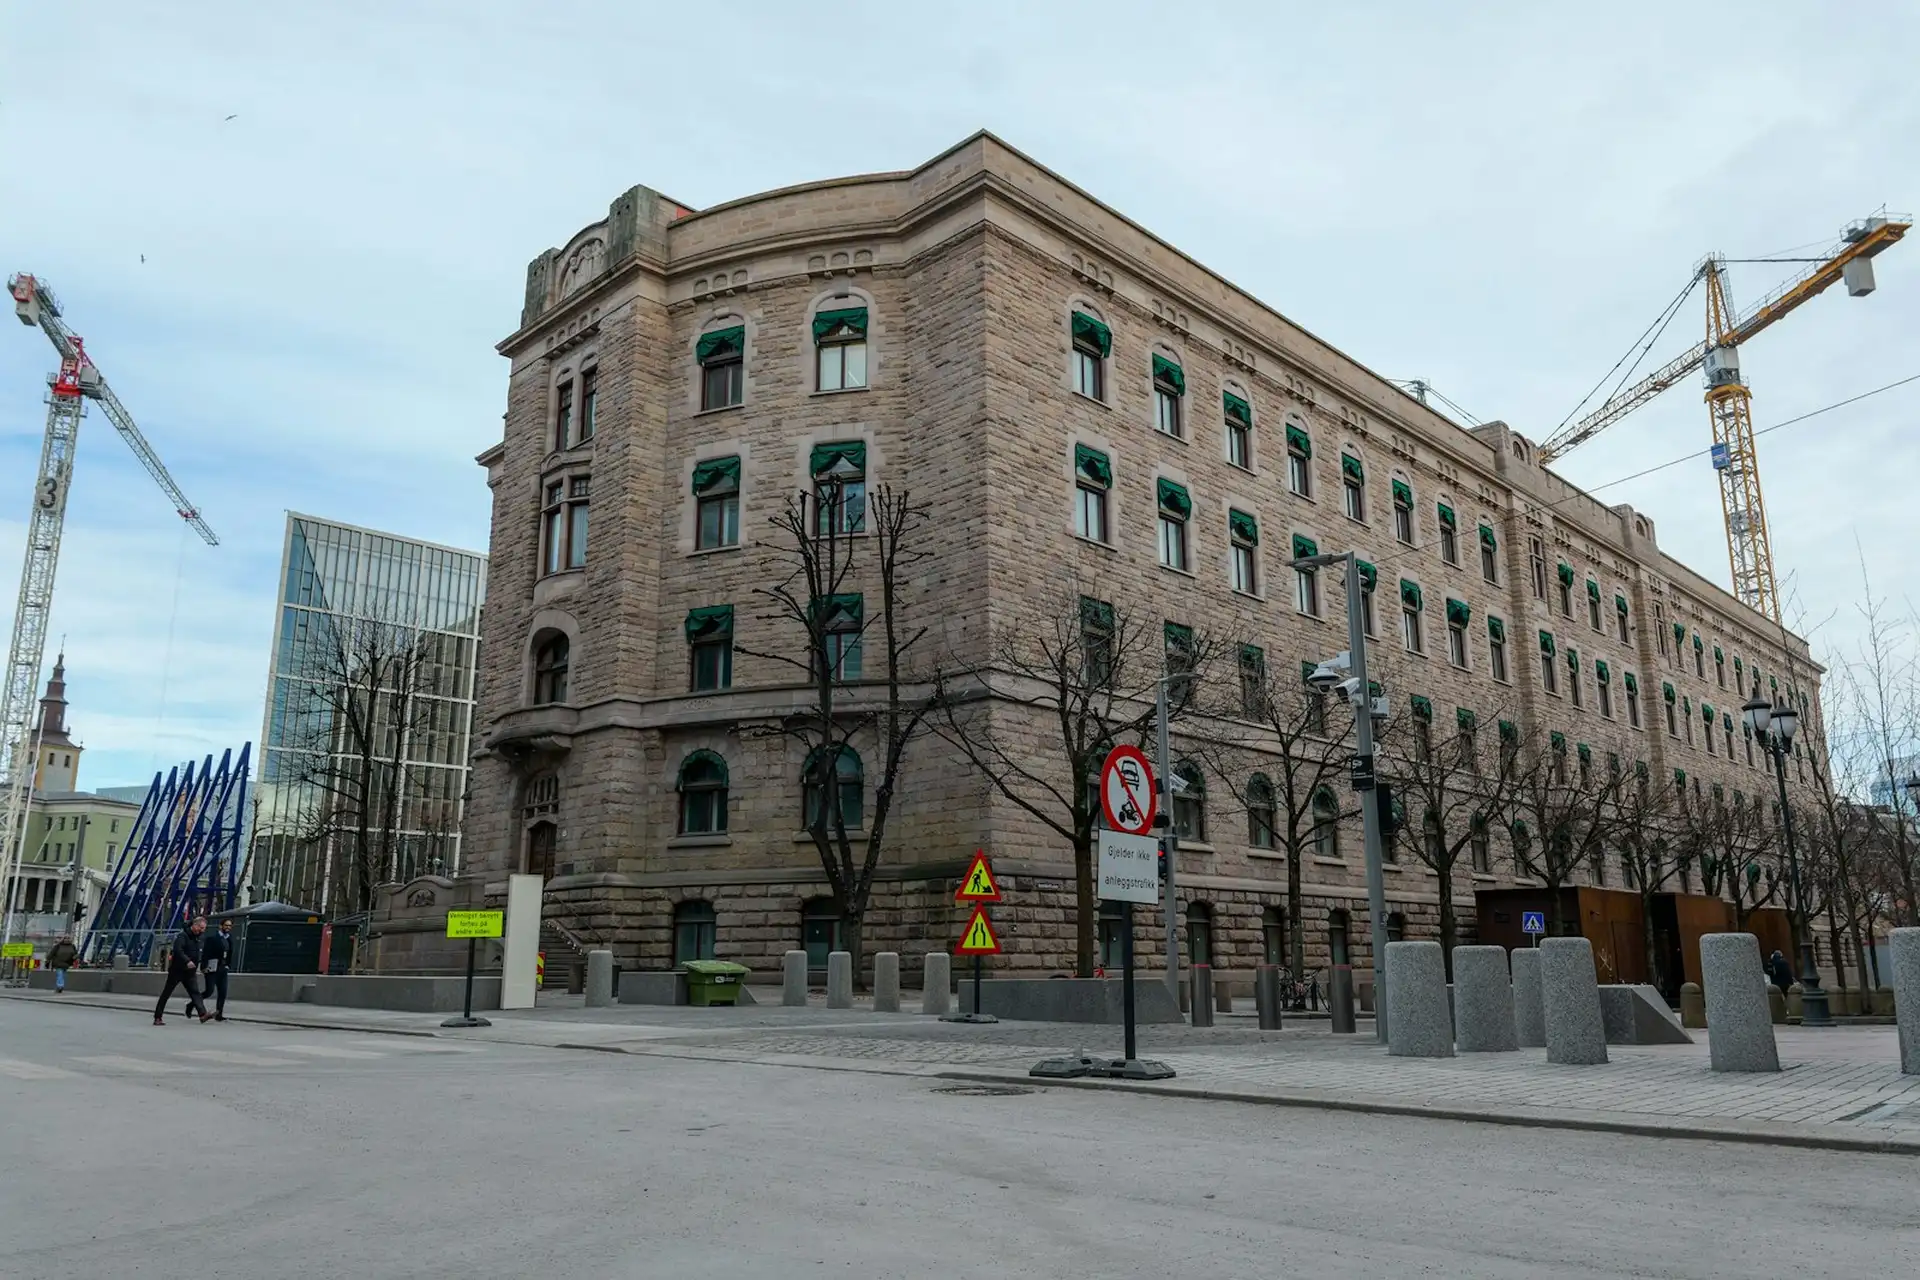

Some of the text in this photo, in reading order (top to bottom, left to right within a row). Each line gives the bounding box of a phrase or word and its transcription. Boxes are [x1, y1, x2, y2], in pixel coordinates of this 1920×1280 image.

[40, 478, 57, 508] 3
[1108, 845, 1151, 861] Gjelder ikke
[1104, 875, 1156, 890] anleggstrafikk
